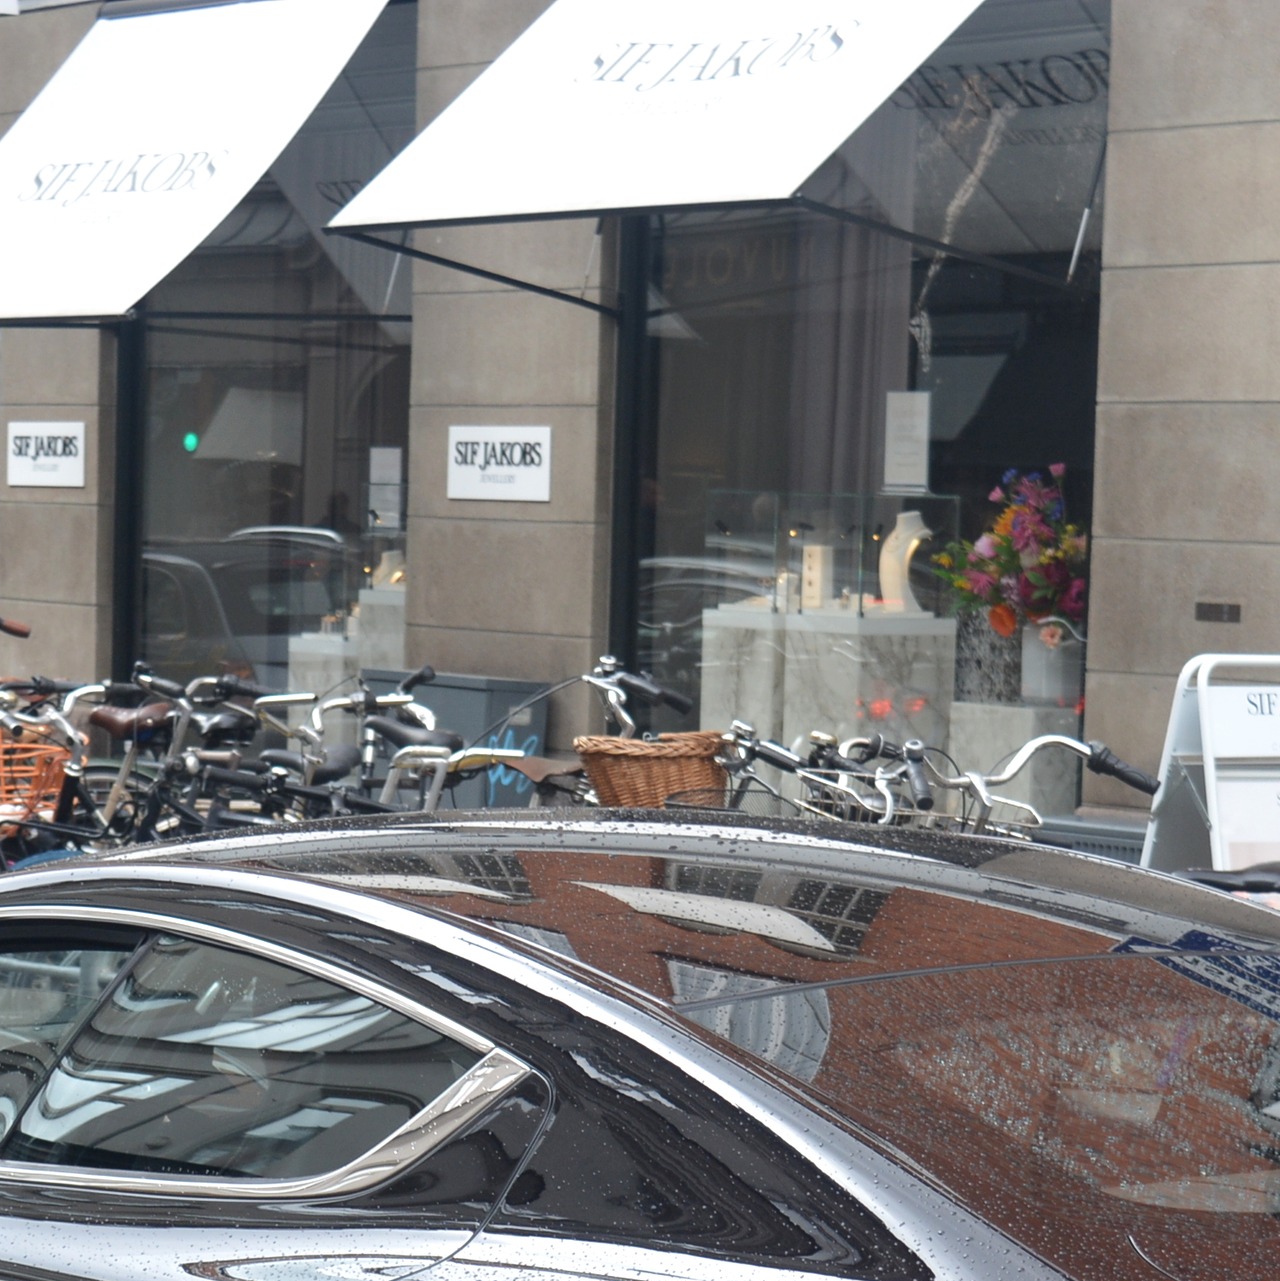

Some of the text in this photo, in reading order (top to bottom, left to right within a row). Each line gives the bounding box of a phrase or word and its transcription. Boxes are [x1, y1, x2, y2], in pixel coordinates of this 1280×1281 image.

[17, 149, 231, 208] SIF JAKOBS
[454, 441, 543, 471] SIF JAKOBS
[1246, 692, 1278, 716] SIF
